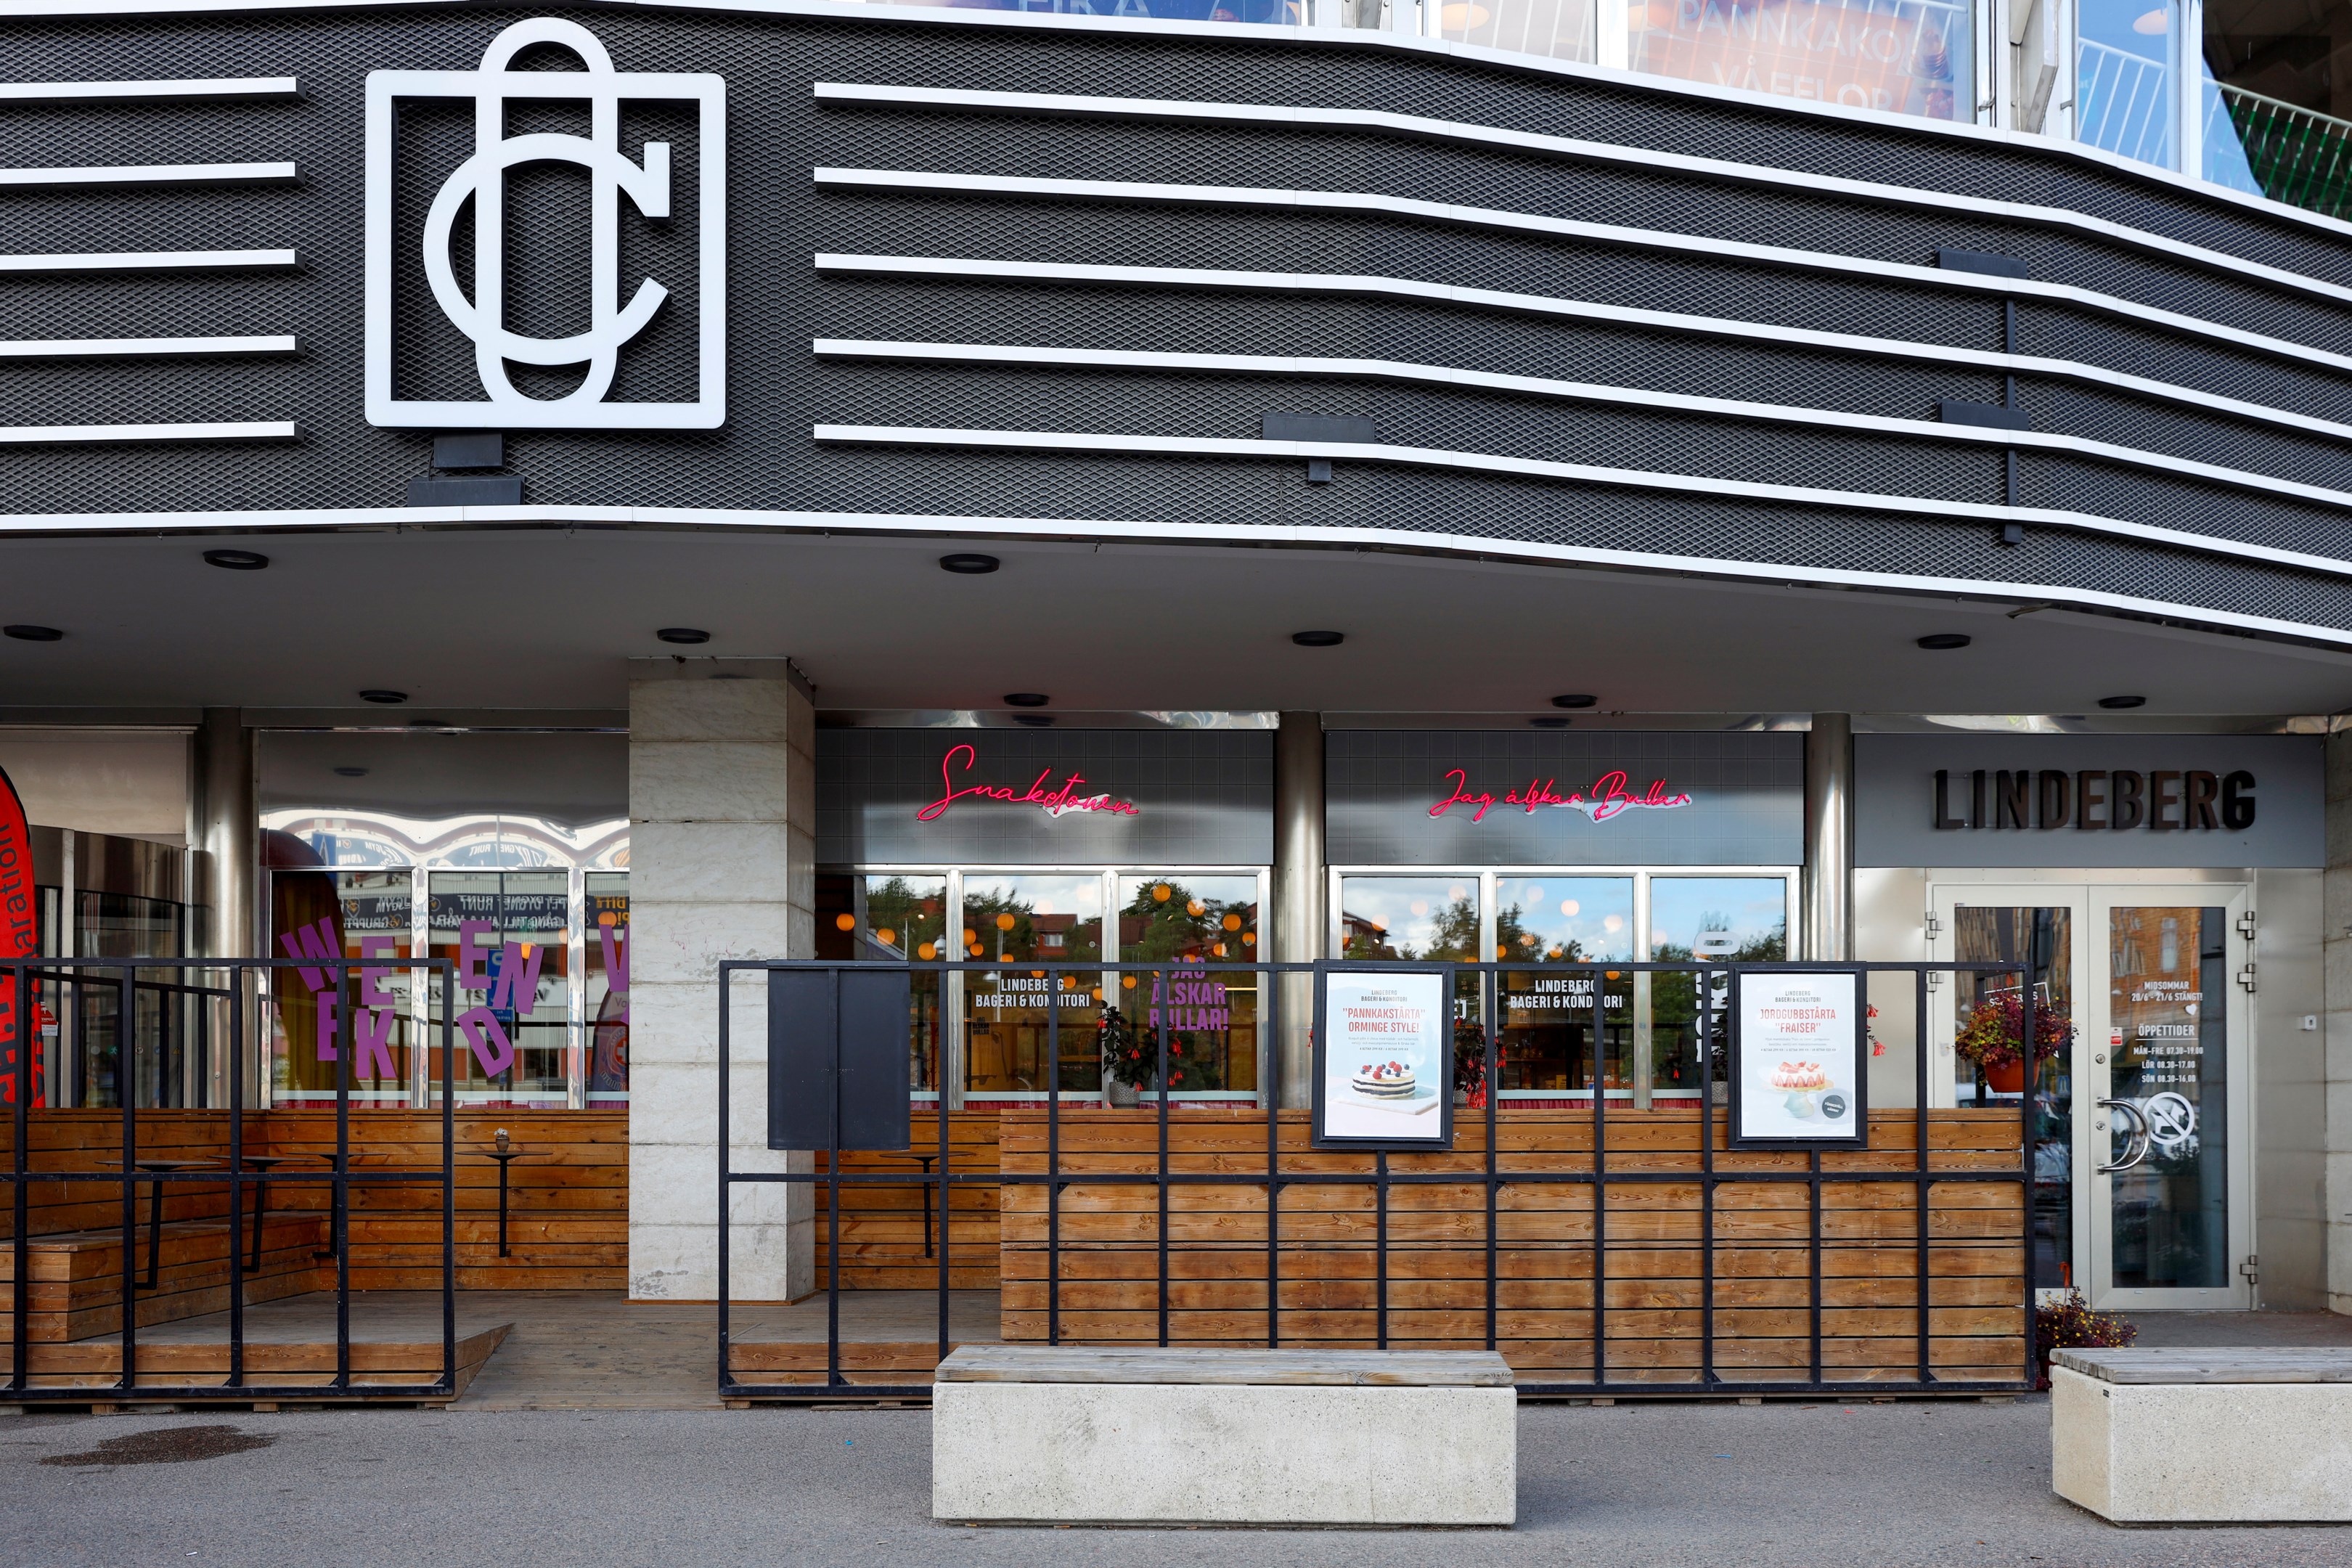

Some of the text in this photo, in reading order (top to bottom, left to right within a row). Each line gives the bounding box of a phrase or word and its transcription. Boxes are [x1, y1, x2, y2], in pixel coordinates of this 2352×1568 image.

[1429, 769, 1497, 822] Jag
[1935, 769, 2256, 829] LINDEBERG
[1000, 979, 1064, 992] LINDEBEG
[2144, 981, 2189, 990] MIDSOMMAR
[976, 994, 1090, 1008] BAGERI & KONITORI
[1510, 995, 1622, 1008] BAGERI & KONDORI
[2156, 992, 2173, 1001] 21/6
[2174, 991, 2203, 1001] STÄNGT!
[1760, 1006, 1836, 1019] JORDGUBBSTÅRTA
[1349, 1021, 1419, 1033] ORMINGE STYLE!
[2138, 1024, 2194, 1036] ÖPPETTIDER
[2141, 1060, 2155, 1069] LÖR
[2141, 1074, 2155, 1082] SÖN
